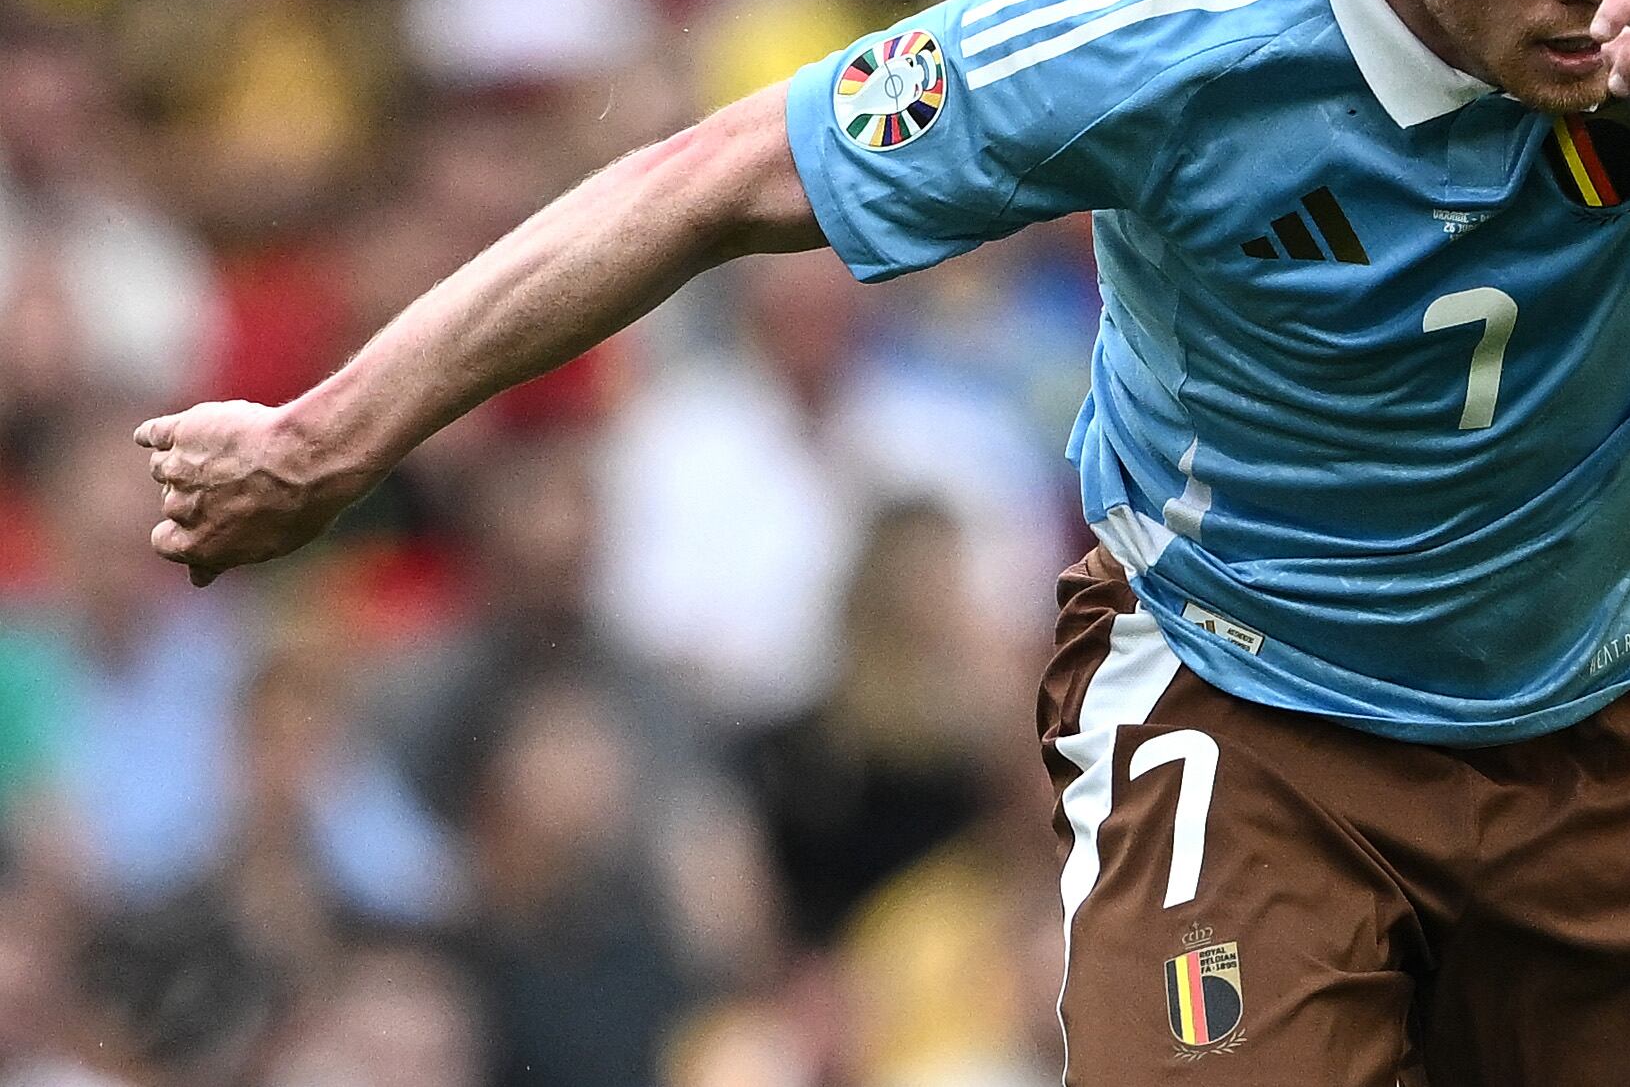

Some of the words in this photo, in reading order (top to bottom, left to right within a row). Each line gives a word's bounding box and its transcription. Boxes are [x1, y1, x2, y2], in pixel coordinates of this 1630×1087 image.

[1422, 286, 1519, 430] 7
[1128, 728, 1221, 910] 7
[1199, 946, 1227, 958] ROYAL
